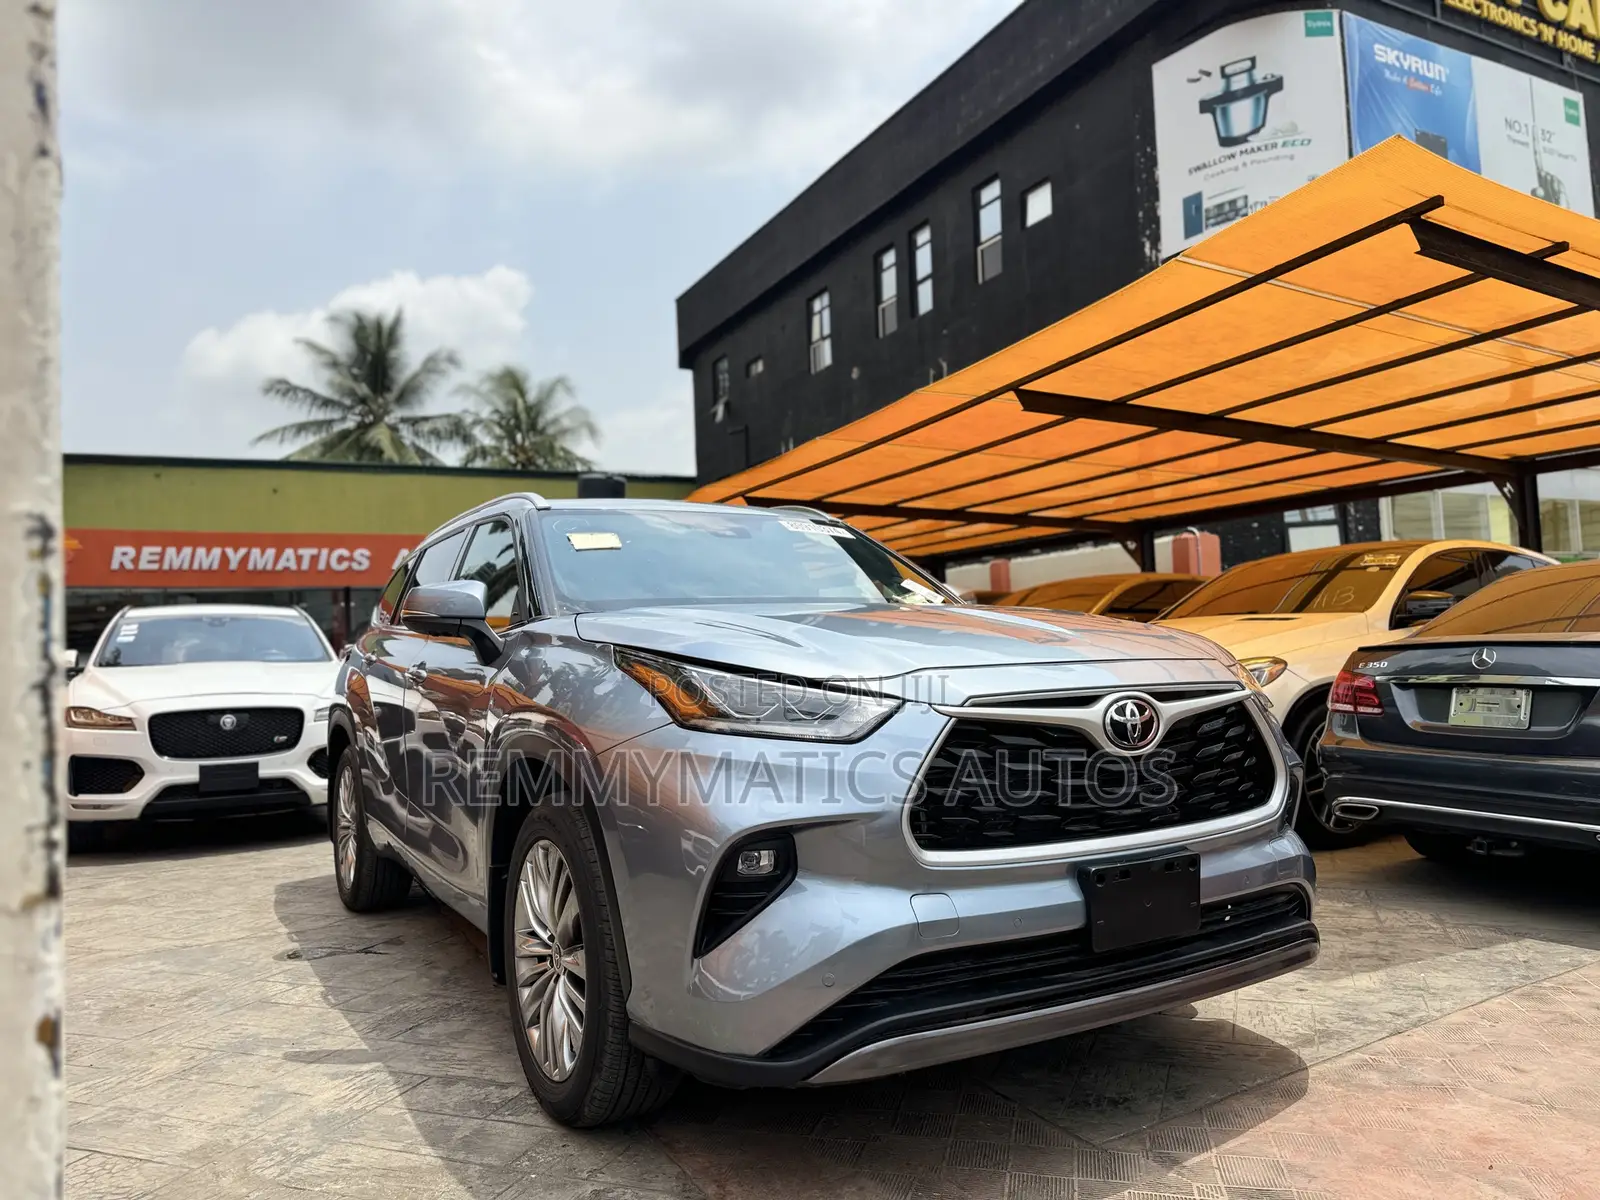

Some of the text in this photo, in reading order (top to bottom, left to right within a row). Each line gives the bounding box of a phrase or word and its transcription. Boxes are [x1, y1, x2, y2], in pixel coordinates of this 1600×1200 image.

[1556, 30, 1597, 61] HOME
[1504, 116, 1530, 137] NO.1
[1188, 138, 1312, 176] SWALLOW MAKER ECO
[110, 545, 371, 572] REMMYMATICS
